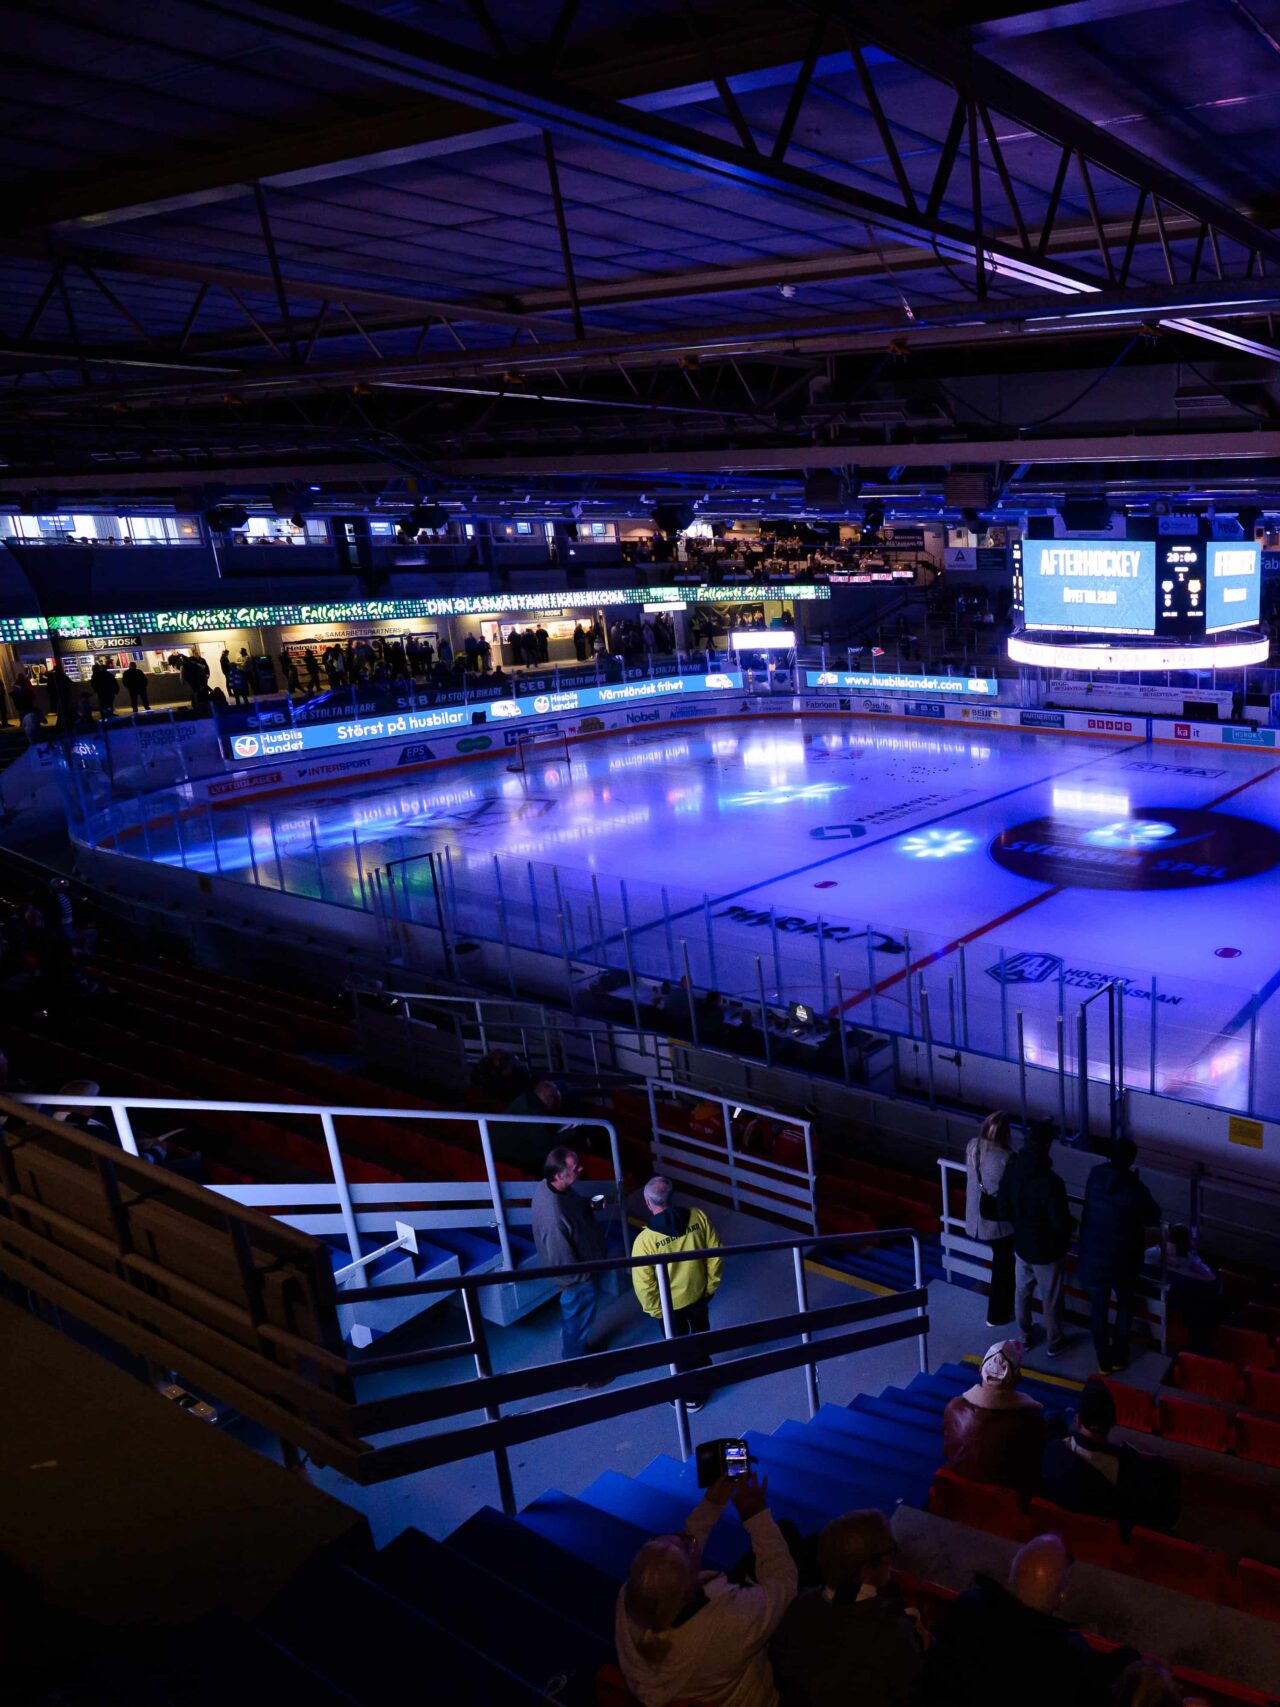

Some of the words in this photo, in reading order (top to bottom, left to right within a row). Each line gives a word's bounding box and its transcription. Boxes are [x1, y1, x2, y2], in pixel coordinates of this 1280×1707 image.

[1040, 549, 1140, 577] AFTERHOCKEY
[1167, 552, 1197, 562] 20:00
[237, 608, 269, 622] Glas
[367, 601, 395, 616] Glas
[325, 627, 402, 638] SAMARBETSPARTNERS
[108, 637, 137, 648] KIOSK
[520, 681, 545, 691] SEB
[657, 679, 683, 691] frihet
[844, 675, 963, 691] www.husbilslandet.com
[397, 695, 428, 707] SEB
[338, 720, 383, 740] Störst
[387, 716, 406, 734] på
[409, 711, 464, 729] husbilar
[261, 730, 302, 745] Husbils
[262, 740, 304, 755] landet
[406, 744, 424, 757] EPS
[308, 757, 372, 776] INTERSPORT
[1153, 859, 1230, 878] SPEL
